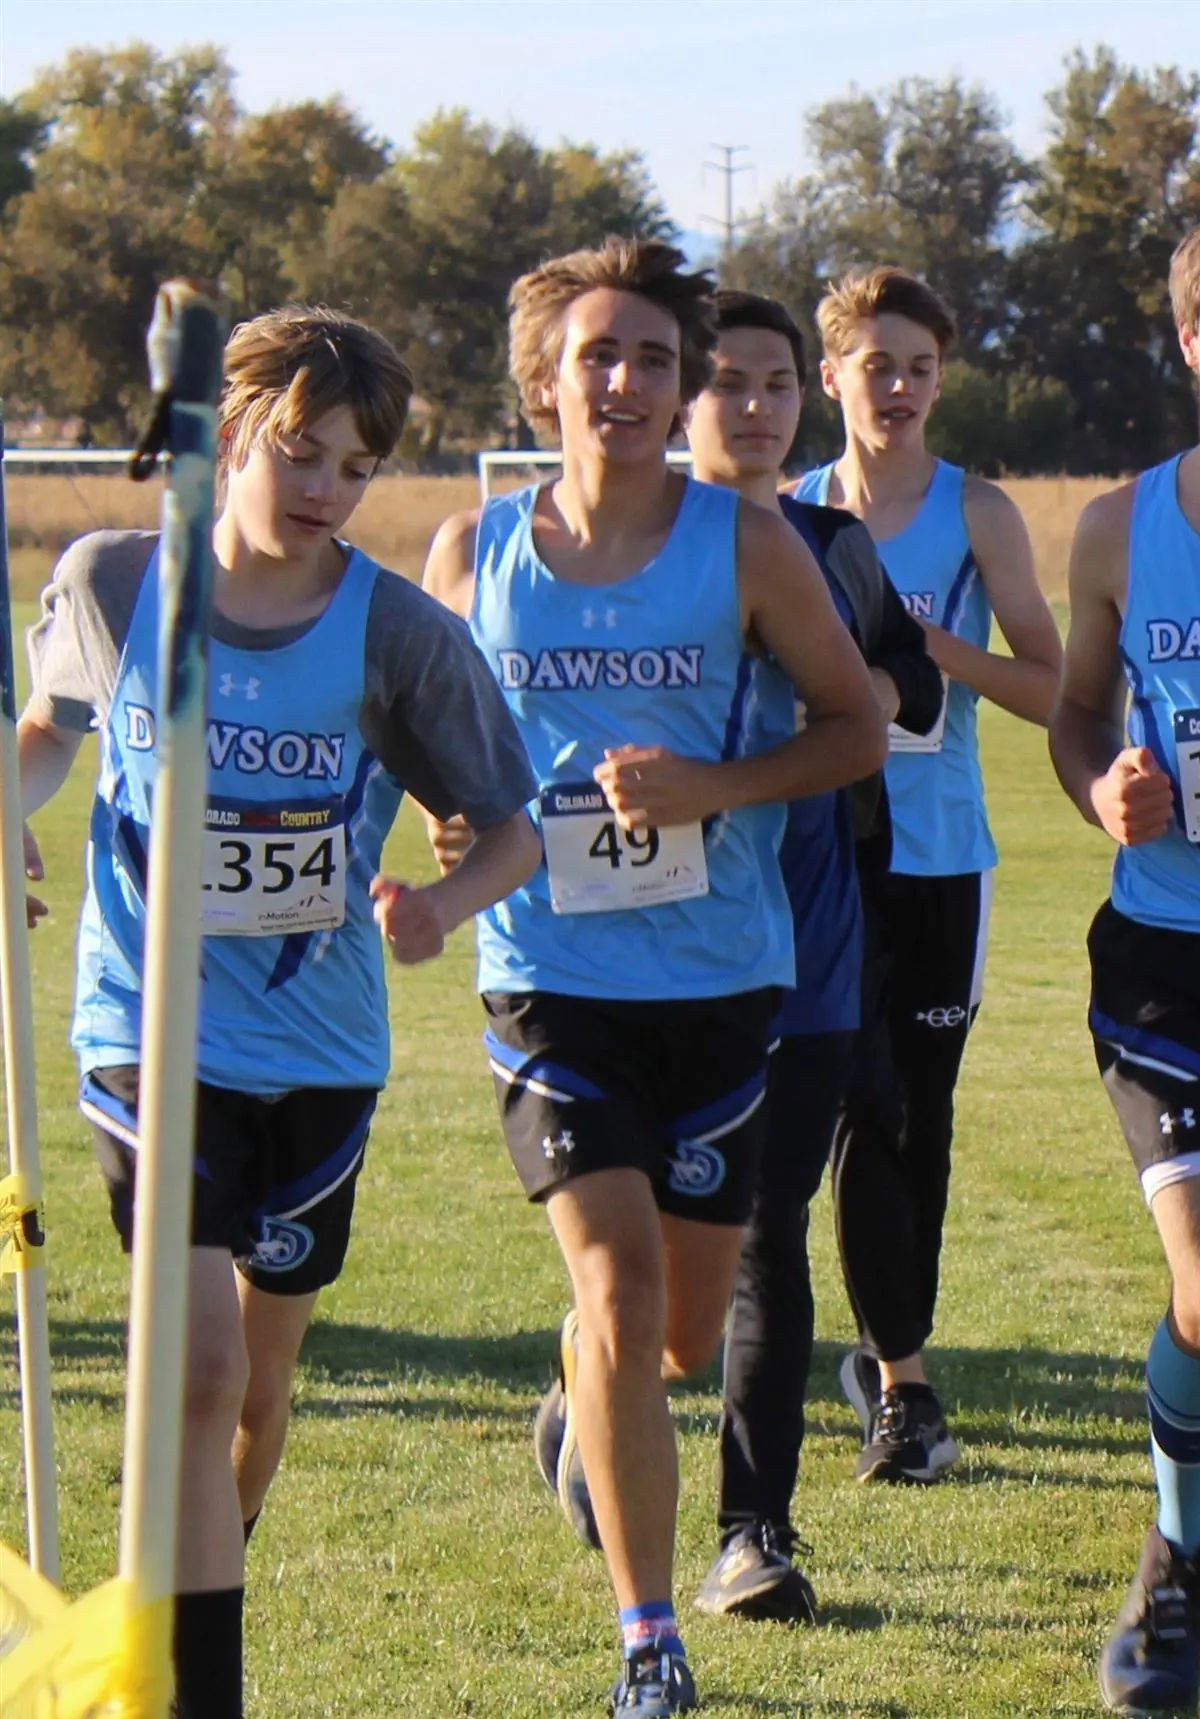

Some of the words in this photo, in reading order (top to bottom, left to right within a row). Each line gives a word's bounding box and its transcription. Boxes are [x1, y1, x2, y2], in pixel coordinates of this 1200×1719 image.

[497, 645, 704, 691] DAWSON
[124, 702, 345, 780] DWSON
[205, 809, 241, 826] ORADO
[280, 809, 331, 827] COUNTRY
[202, 837, 337, 894] 354
[589, 822, 661, 869] 49
